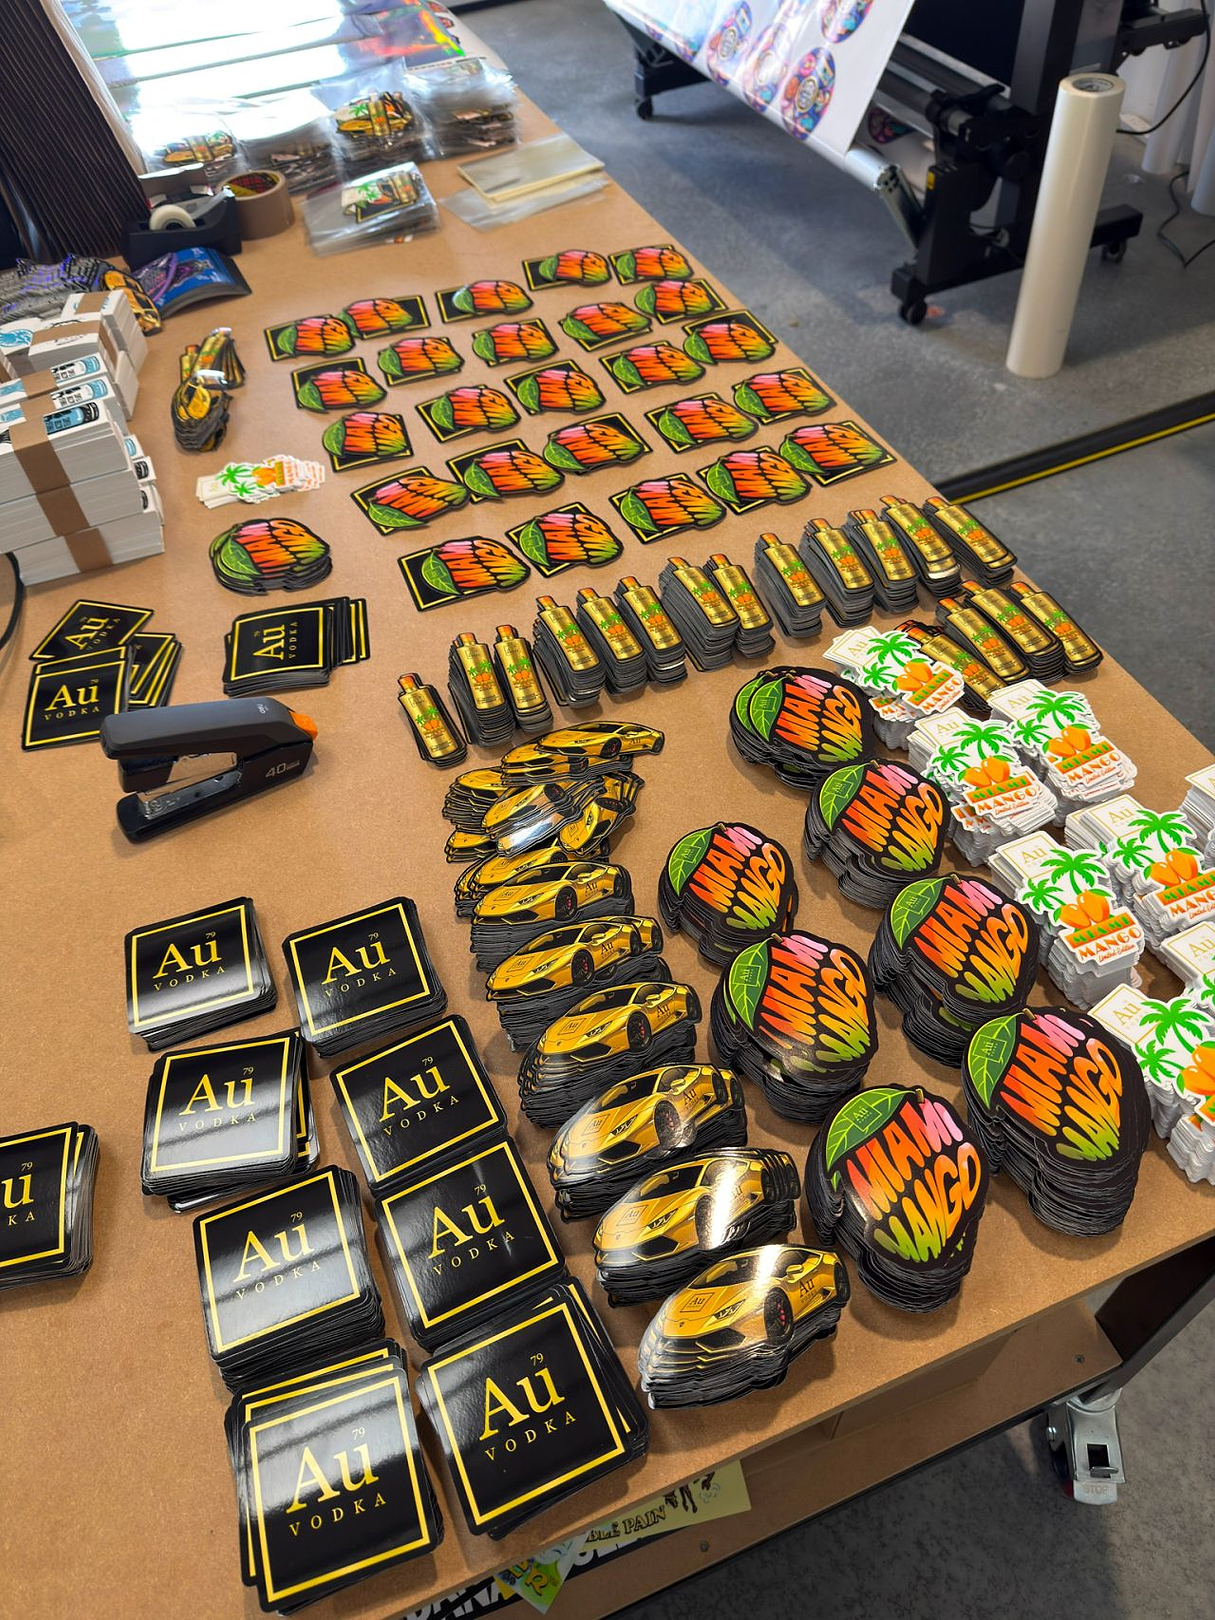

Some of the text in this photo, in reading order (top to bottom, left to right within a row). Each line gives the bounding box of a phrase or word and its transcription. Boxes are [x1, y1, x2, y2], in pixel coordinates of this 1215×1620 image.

[65, 617, 110, 650] Au
[253, 624, 285, 660] Au
[289, 621, 298, 659] VODKA
[847, 640, 868, 657] Au
[45, 684, 99, 711] Au
[922, 678, 963, 711] MANGO
[1007, 696, 1031, 709] Au
[45, 706, 100, 720] VODKA
[775, 674, 832, 751] MIAMI
[936, 722, 960, 734] Au
[265, 763, 286, 777] 40
[1061, 743, 1110, 770] MIAMI
[1067, 751, 1121, 782] MANGO
[973, 778, 1027, 800] MIAMI
[978, 787, 1038, 813] MANGO
[841, 764, 918, 852] MIAMI
[1108, 807, 1134, 824] Au
[689, 826, 762, 913] MIAMI
[1021, 847, 1047, 864] Au
[205, 931, 216, 940] 79
[368, 932, 379, 941] 79
[914, 880, 1003, 978] MIAMI
[1073, 916, 1130, 943] MIAMI
[600, 942, 614, 955] Au
[1078, 928, 1142, 960] MANGO
[153, 940, 222, 979] Au
[321, 939, 391, 985] Au
[153, 966, 226, 991] VODKA
[325, 967, 397, 997] VODKA
[758, 934, 828, 1050] MIAMI
[656, 1003, 670, 1017] Au
[1113, 1001, 1141, 1026] Au
[243, 1066, 254, 1075] 79
[422, 1056, 434, 1067] 79
[1000, 1014, 1086, 1137] MIAMI
[179, 1074, 255, 1116] Au
[379, 1065, 450, 1123] Au
[683, 1089, 697, 1105] Au
[178, 1112, 257, 1132] VODKA
[383, 1095, 460, 1136] VODKA
[21, 1162, 33, 1171] 79
[846, 1099, 963, 1221] MIAMI
[1, 1174, 34, 1209] u
[474, 1184, 487, 1197] 79
[291, 1211, 303, 1223] 79
[427, 1192, 505, 1259] Au
[233, 1220, 315, 1283] Au
[433, 1230, 515, 1276] VODKA
[235, 1261, 322, 1300] VODKA
[799, 1279, 814, 1297] Au
[530, 1352, 545, 1366] 79
[479, 1365, 565, 1441] Au
[352, 1427, 366, 1440] 79
[484, 1410, 577, 1462] VODKA
[285, 1440, 380, 1514] Au
[289, 1492, 387, 1537] VODKA
